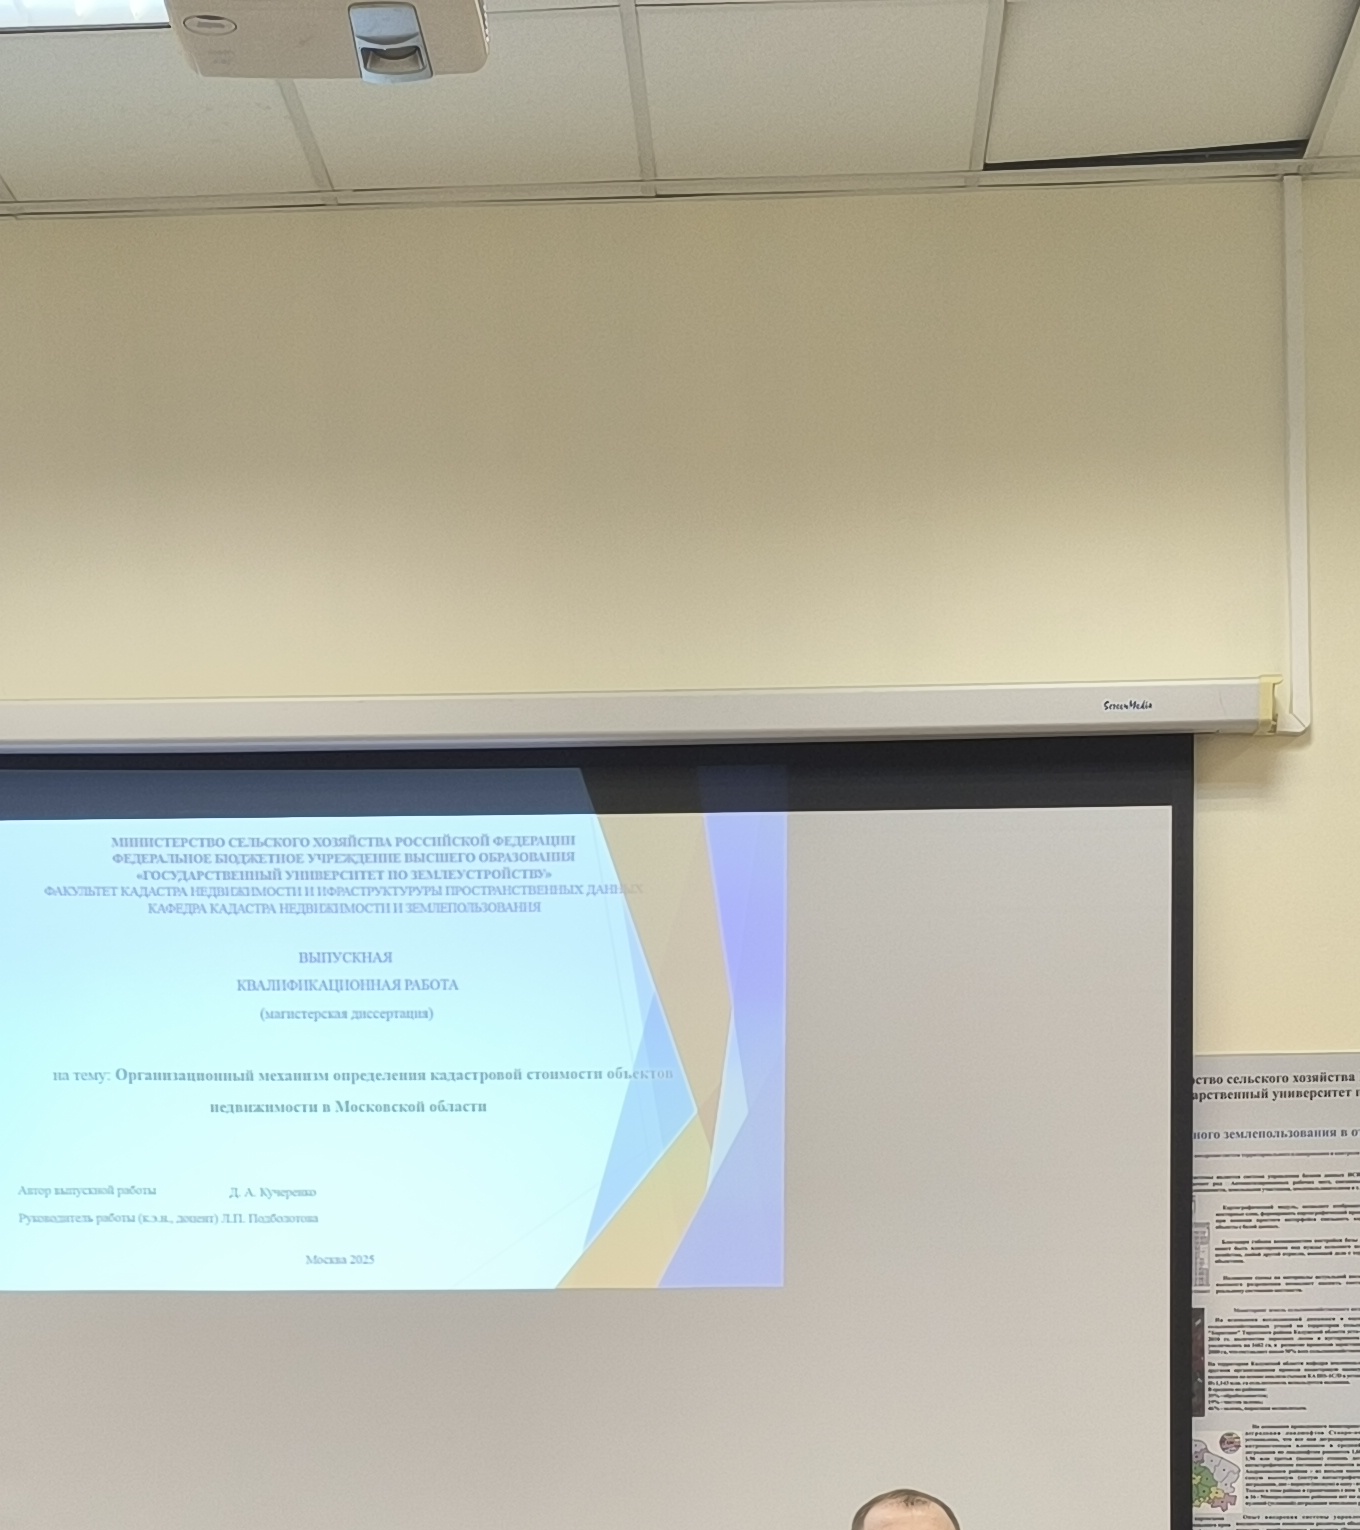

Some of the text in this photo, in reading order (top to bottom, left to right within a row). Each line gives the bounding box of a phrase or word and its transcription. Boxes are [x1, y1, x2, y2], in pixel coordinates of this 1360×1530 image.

[112, 834, 575, 848] МИНИСТЕРСТВО СЕЛЬСКОГО ХОЗЯЙСТВА РОССИЙСКОЙ ФЕДЕРАЦИИ
[112, 852, 575, 865] ФЕДЕРАЛЬНОЕ БЮДЖЕТНОЕ УЧРЕЖДЕНИЕ ВЫСШЕГО ОБРАЗОВАНИЯ
[137, 867, 552, 882] «ГОСУДАРСТВЕННЫЙ УНИВЕРСИТЕТ ПО ЗЕМЛЕУСТРОЙСТВУ»
[44, 886, 118, 896] ФАКУЛЬТЕТ
[121, 886, 188, 898] КАДАСТРА
[191, 886, 302, 899] НЕДВИЖИМОСТИ
[305, 886, 314, 896] И
[445, 885, 584, 896] ПРОСТРАНСТВЕННЫХ
[148, 902, 541, 915] КАФЕДРА КАДАСТРА НЕДВИЖИМОСТИ И ЗЕМЛЕПОЛЬЗОВАНИЯ
[299, 952, 392, 963] ВЫПУСКНАЯ
[237, 979, 458, 992] КВАЛИФИКАЦИОННАЯ РАБОТА
[260, 1008, 433, 1022] (магистерская диссертация)
[53, 1067, 673, 1084] на тему: Организационный механизм определения кадастровой стоимости объектов
[1227, 1076, 1289, 1084] сельского
[1293, 1072, 1355, 1082] хозяйства
[1272, 1090, 1352, 1101] университет
[211, 1100, 486, 1113] недвижимости в Московской области
[1224, 1130, 1336, 1139] землепользования
[18, 1186, 51, 1198] Автор
[117, 1185, 156, 1198] работы
[96, 1213, 135, 1225] работы
[306, 1255, 374, 1264] Москва 2025
